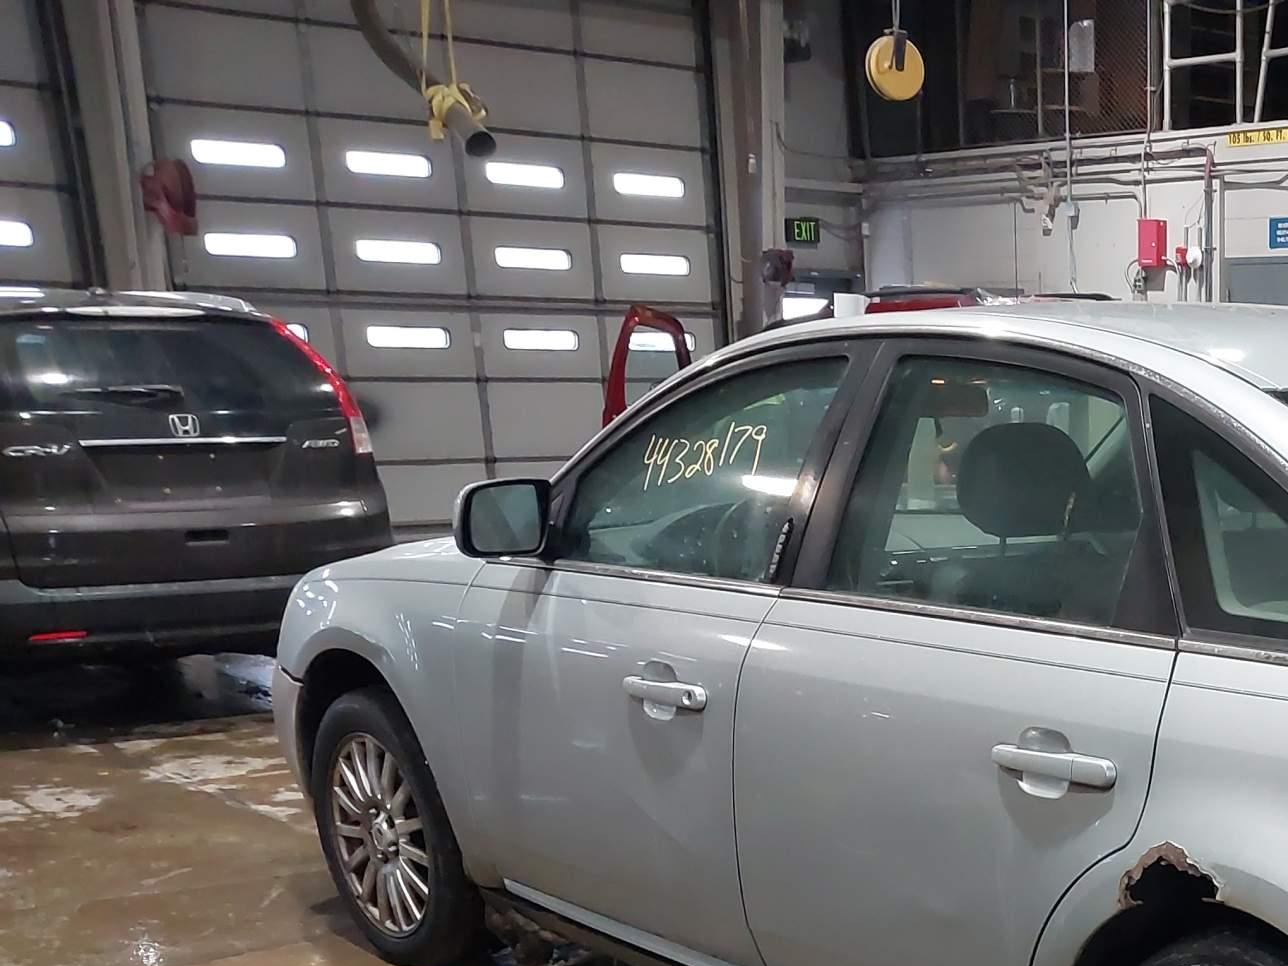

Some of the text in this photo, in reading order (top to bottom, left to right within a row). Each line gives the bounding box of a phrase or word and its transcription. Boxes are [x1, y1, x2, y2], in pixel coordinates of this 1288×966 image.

[1228, 133, 1241, 145] 105
[1242, 131, 1255, 144] lbs.
[1262, 130, 1274, 142] SQ.
[794, 221, 816, 241] EXIT
[643, 421, 767, 491] 44328179
